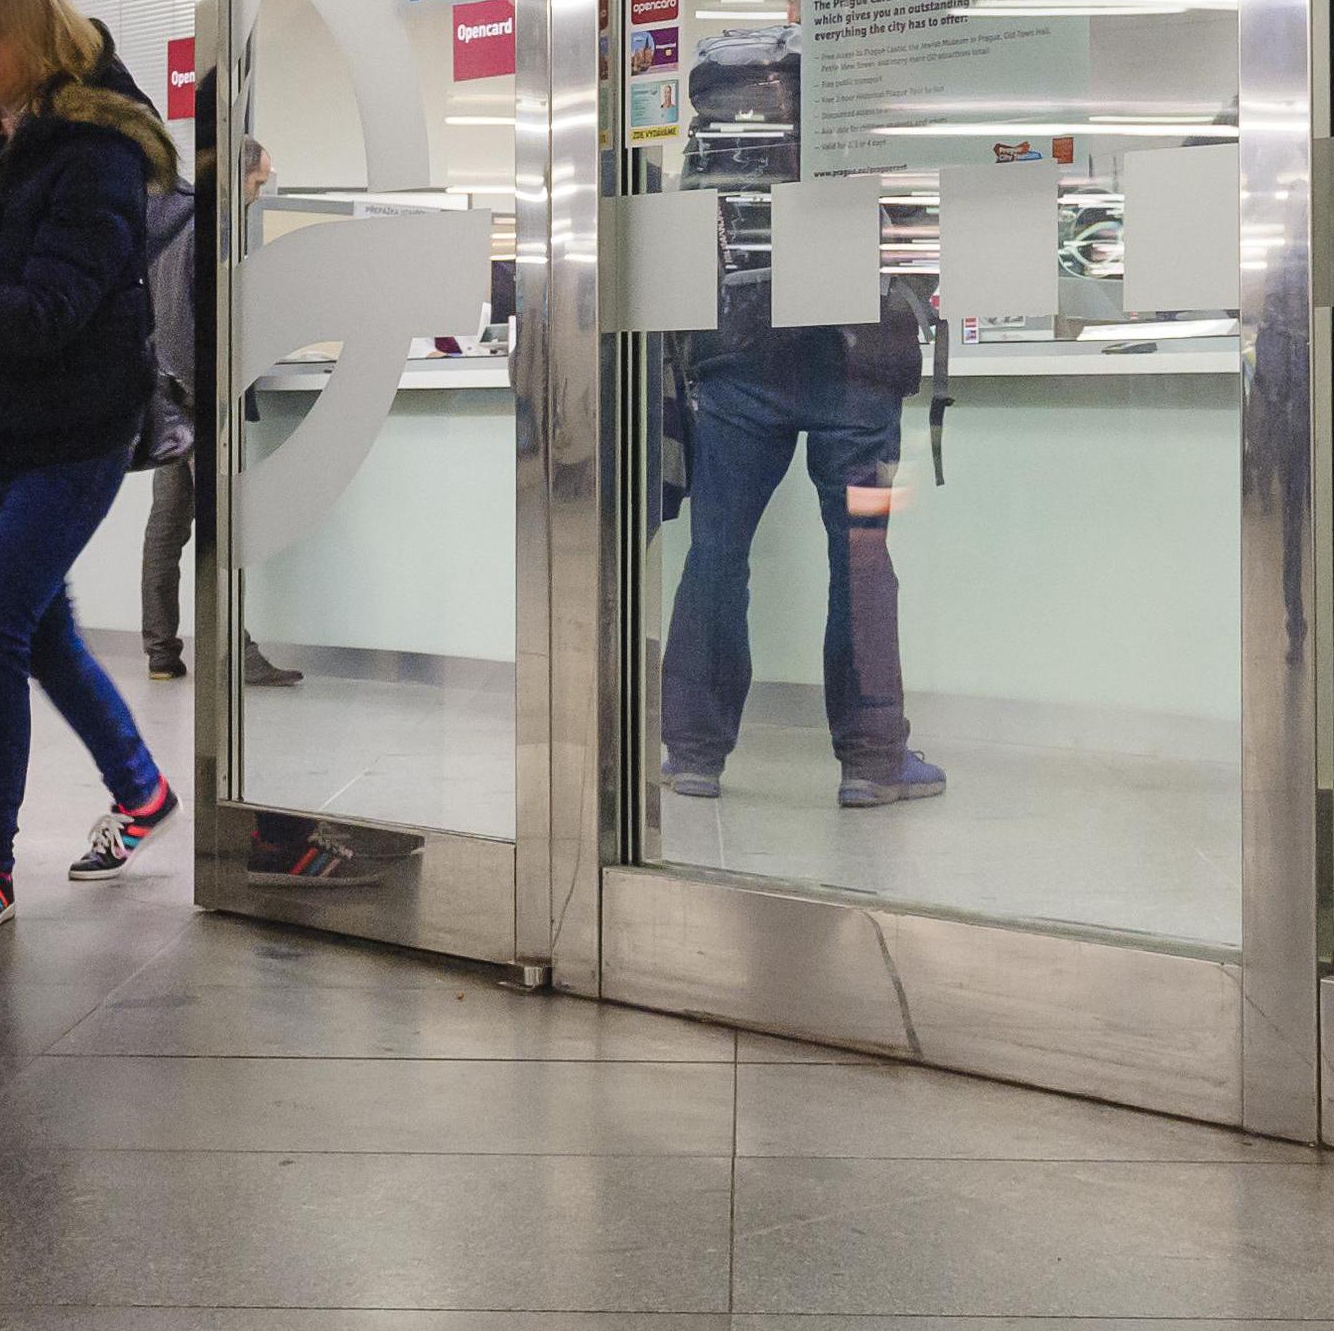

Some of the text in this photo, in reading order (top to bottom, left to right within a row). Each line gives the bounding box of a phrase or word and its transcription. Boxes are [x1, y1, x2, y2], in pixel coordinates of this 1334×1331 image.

[814, 1, 830, 11] The
[814, 14, 842, 26] which
[846, 11, 870, 24] gives
[873, 8, 891, 21] you
[894, 6, 906, 15] an
[457, 18, 513, 43] Opencard
[814, 27, 867, 41] everything
[870, 23, 885, 34] the
[887, 20, 906, 34] city
[908, 17, 926, 29] has
[928, 16, 938, 26] to
